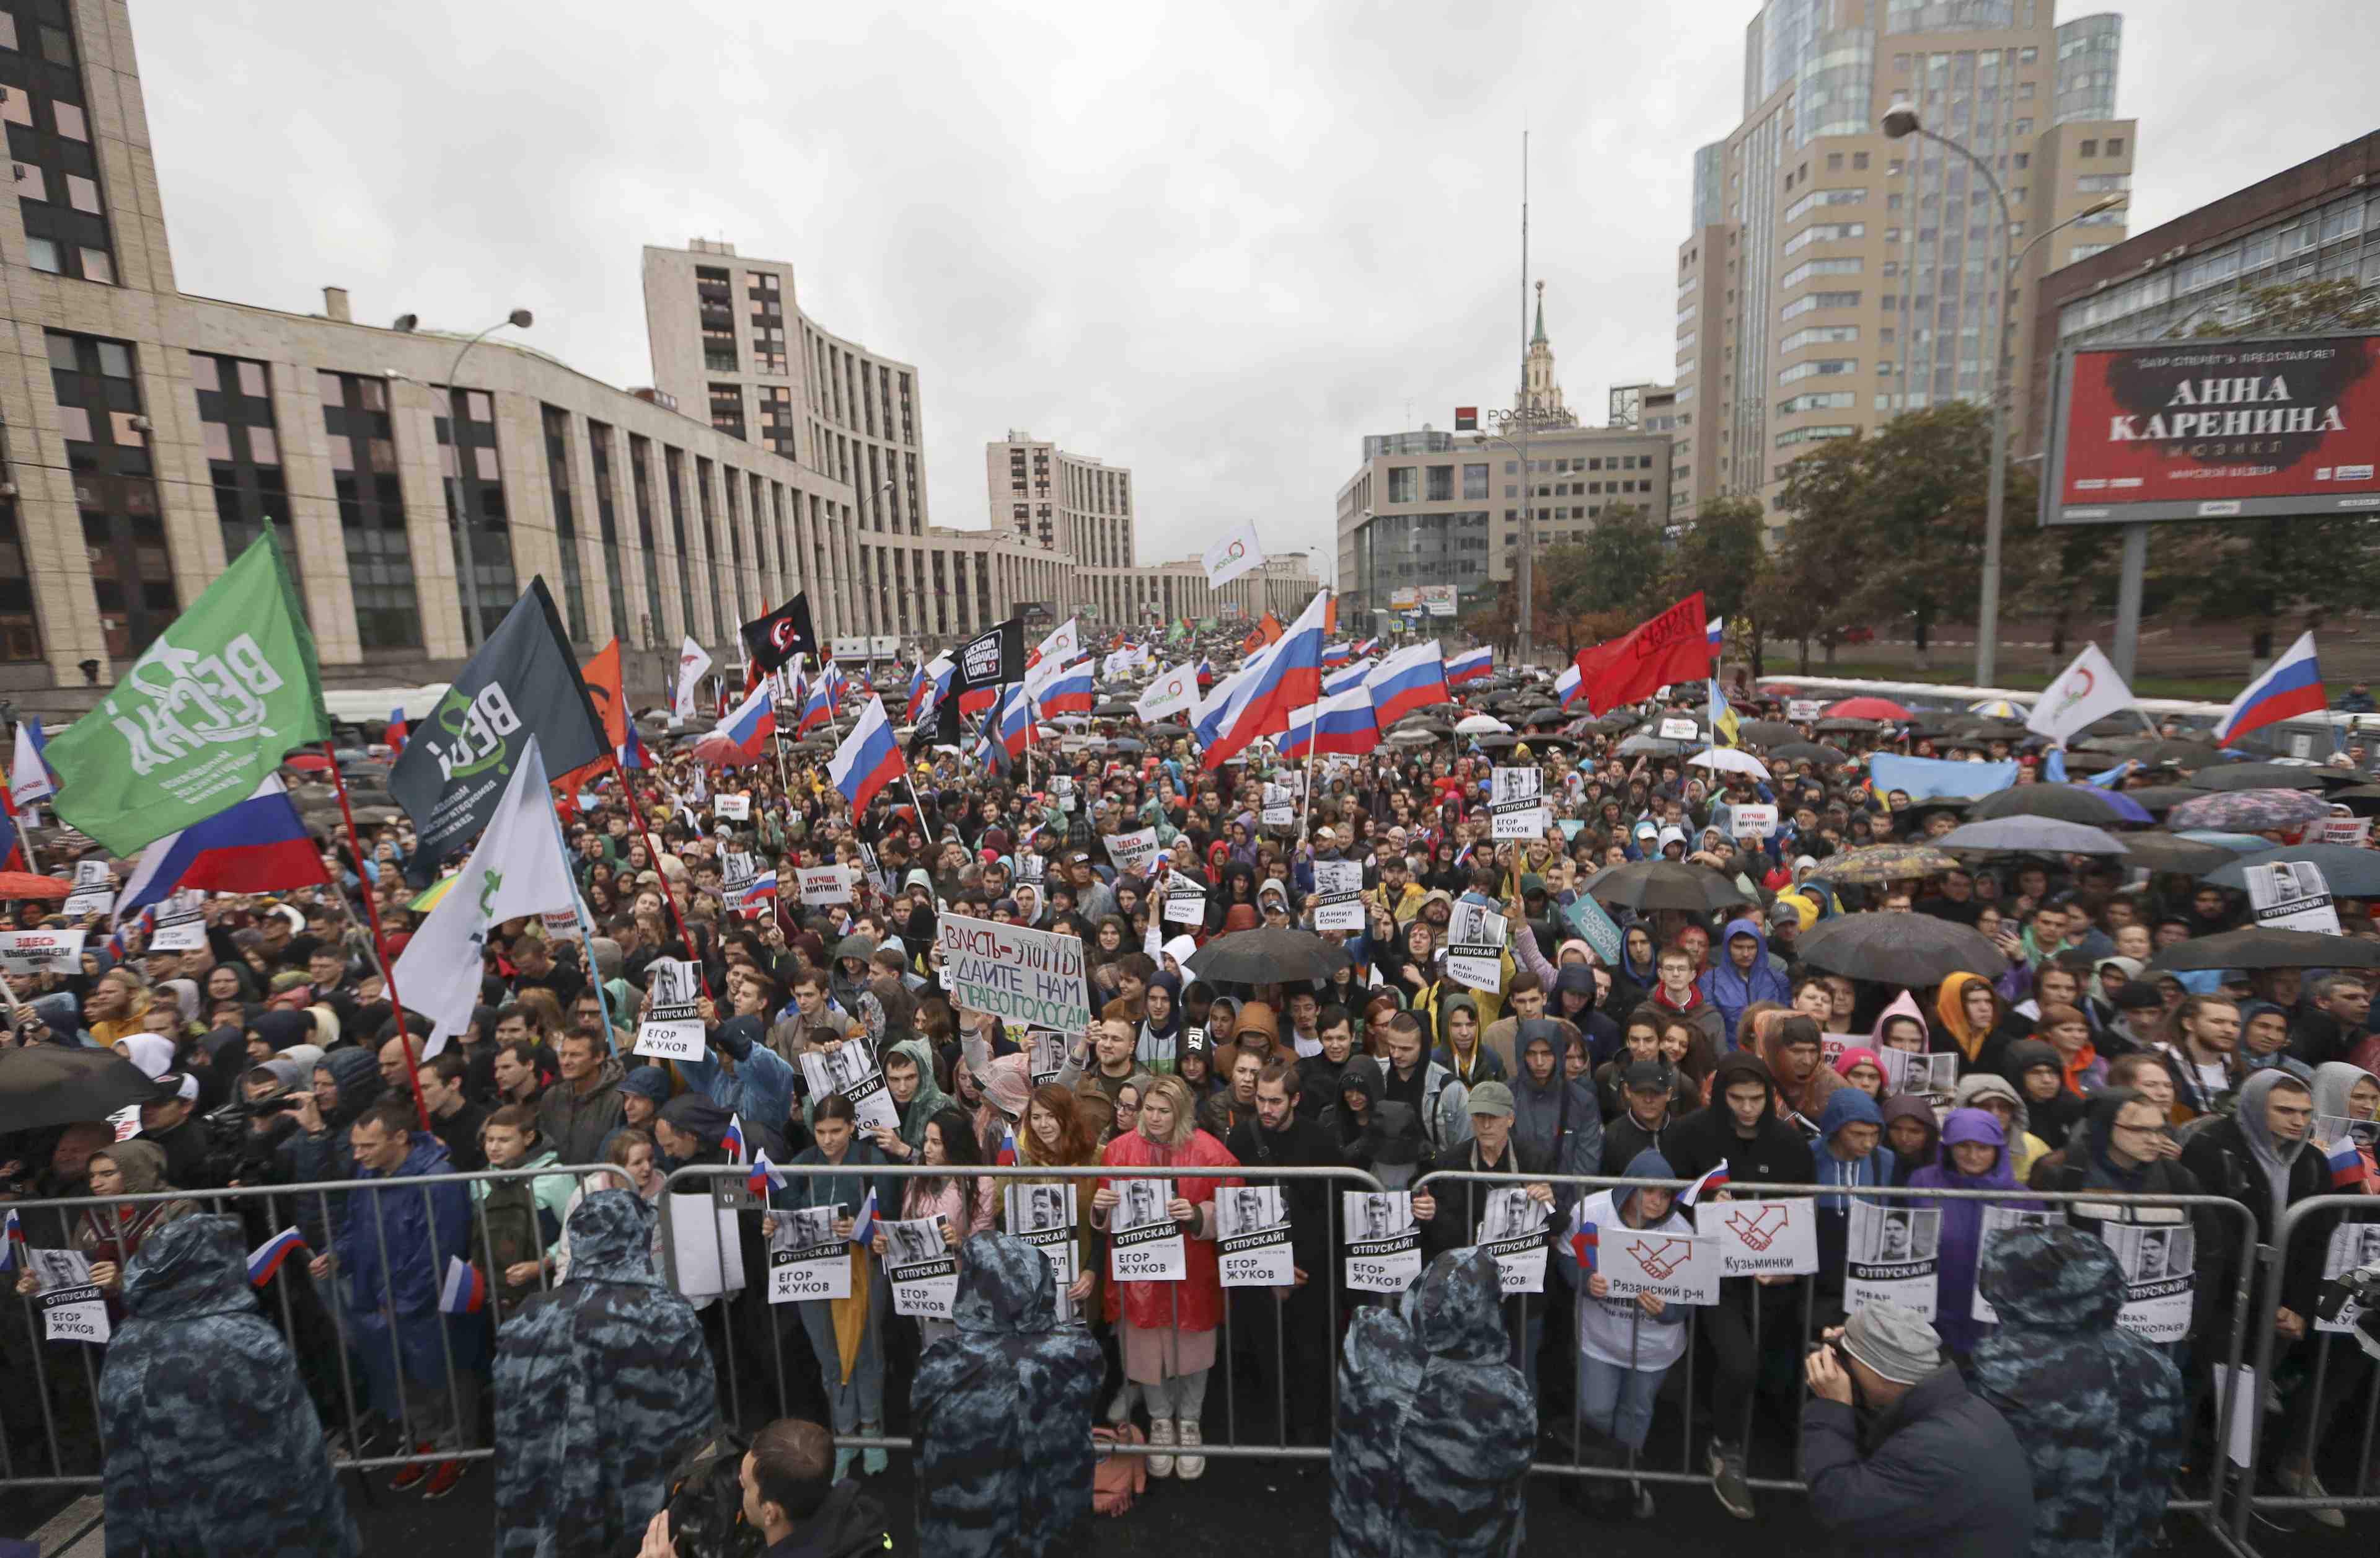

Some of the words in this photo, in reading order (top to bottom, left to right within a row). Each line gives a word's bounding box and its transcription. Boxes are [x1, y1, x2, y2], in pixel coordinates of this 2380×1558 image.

[2165, 374, 2293, 407] АННА
[2109, 404, 2347, 441] КАРЕНИНА
[1497, 799, 1537, 813] ОТПУСКАЙ!
[1113, 842, 1154, 857] ВЫБИРАЕМ
[1117, 837, 1141, 849] ЗДЕСЬ
[806, 875, 836, 885] ЛУЧШЕ
[805, 881, 842, 894] МИТИНГ!
[1320, 892, 1359, 905] ОТПУСКАЙ!
[2264, 898, 2325, 918] ОТПУСКАЙ!
[1042, 934, 1082, 978] МЫ
[1453, 947, 1497, 957] ОТПУСКАЙ!
[1453, 962, 1472, 972] ИВАН
[956, 957, 1023, 991] ДАЙТЕ
[1036, 973, 1081, 1006] НАМ
[1453, 970, 1495, 986] ПОДКОПАЕВ
[956, 981, 1010, 1015] ПРАВО
[653, 1006, 697, 1020] ОТПУСКАЙ!
[647, 1029, 677, 1040] ЕГОР
[645, 1040, 687, 1053] ЖУКОВ
[1823, 1041, 1846, 1052] ЕСЬ
[848, 1079, 879, 1102] СКАЙ!
[857, 1118, 879, 1131] КОВ
[1117, 1226, 1177, 1246] ОТПУСКАЙ!
[1225, 1231, 1285, 1251] ОТПУСКАЙ!
[1353, 1237, 1414, 1255] ОТПУСКАЙ!
[779, 1246, 842, 1263] ОТПУСКАЙ!
[1119, 1252, 1150, 1264] ЕГОР
[1119, 1264, 1166, 1275] ЖУКОВ
[1227, 1259, 1258, 1269] ЕГОР
[1353, 1264, 1385, 1275] ЕГОР
[1499, 1265, 1514, 1274] ОР
[1726, 1256, 1794, 1273] Кузьминки
[1856, 1262, 1933, 1278] ОТПУСКАЙ!
[779, 1271, 813, 1283] ЕГОР
[897, 1262, 951, 1280] ОТПУСКАЙ!
[1227, 1270, 1275, 1280] ЖУКОВ
[1353, 1273, 1402, 1286] ЖУКОВ
[1502, 1276, 1527, 1285] КОВ
[778, 1283, 829, 1295] ЖУКОВ
[901, 1289, 928, 1299] ЕГОР
[1613, 1279, 1680, 1297] Рязанский
[1683, 1290, 1704, 1301] р-н
[46, 1289, 100, 1305] ОТПУСКАЙ!
[901, 1300, 945, 1311] ЖУКОВ
[52, 1312, 81, 1322] ЕГОР
[2122, 1313, 2148, 1322] ВАН
[52, 1323, 94, 1335] ЖУКОВ
